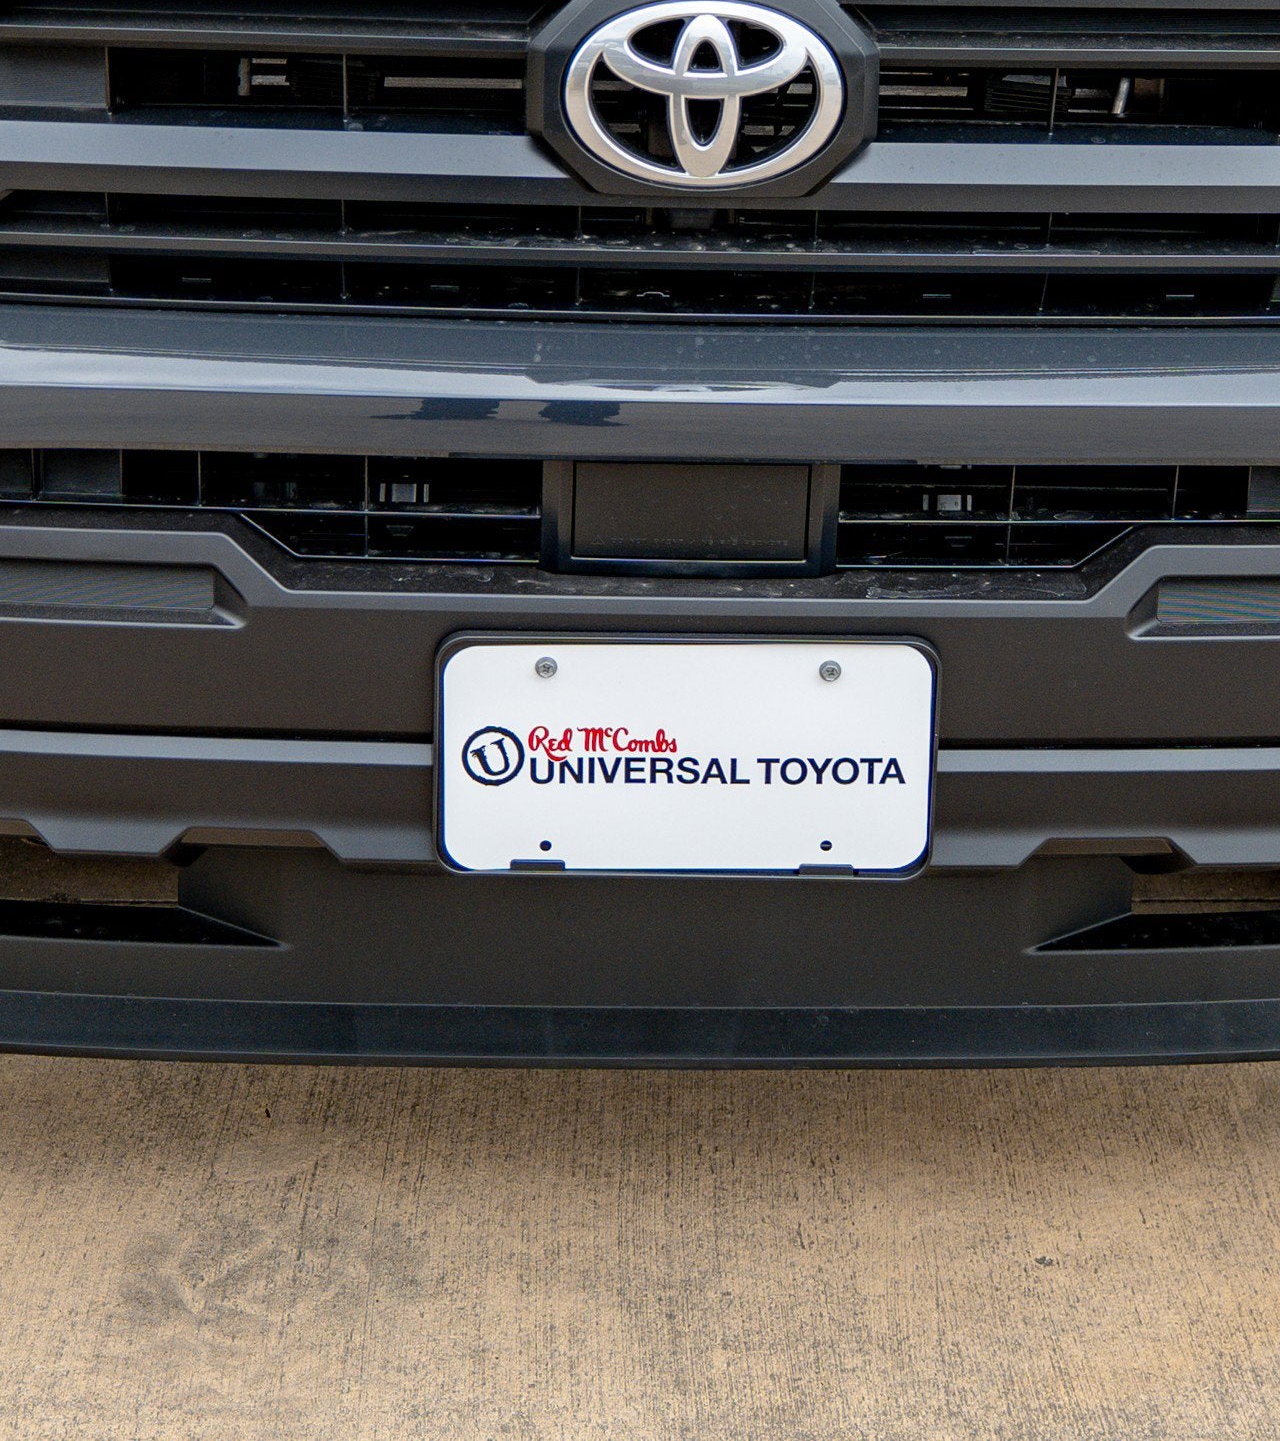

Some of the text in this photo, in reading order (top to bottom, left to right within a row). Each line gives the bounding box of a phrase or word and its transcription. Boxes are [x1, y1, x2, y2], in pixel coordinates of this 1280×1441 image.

[528, 725, 678, 762] Red McCombs
[529, 757, 907, 786] UNIVERSAL TOYOTA
